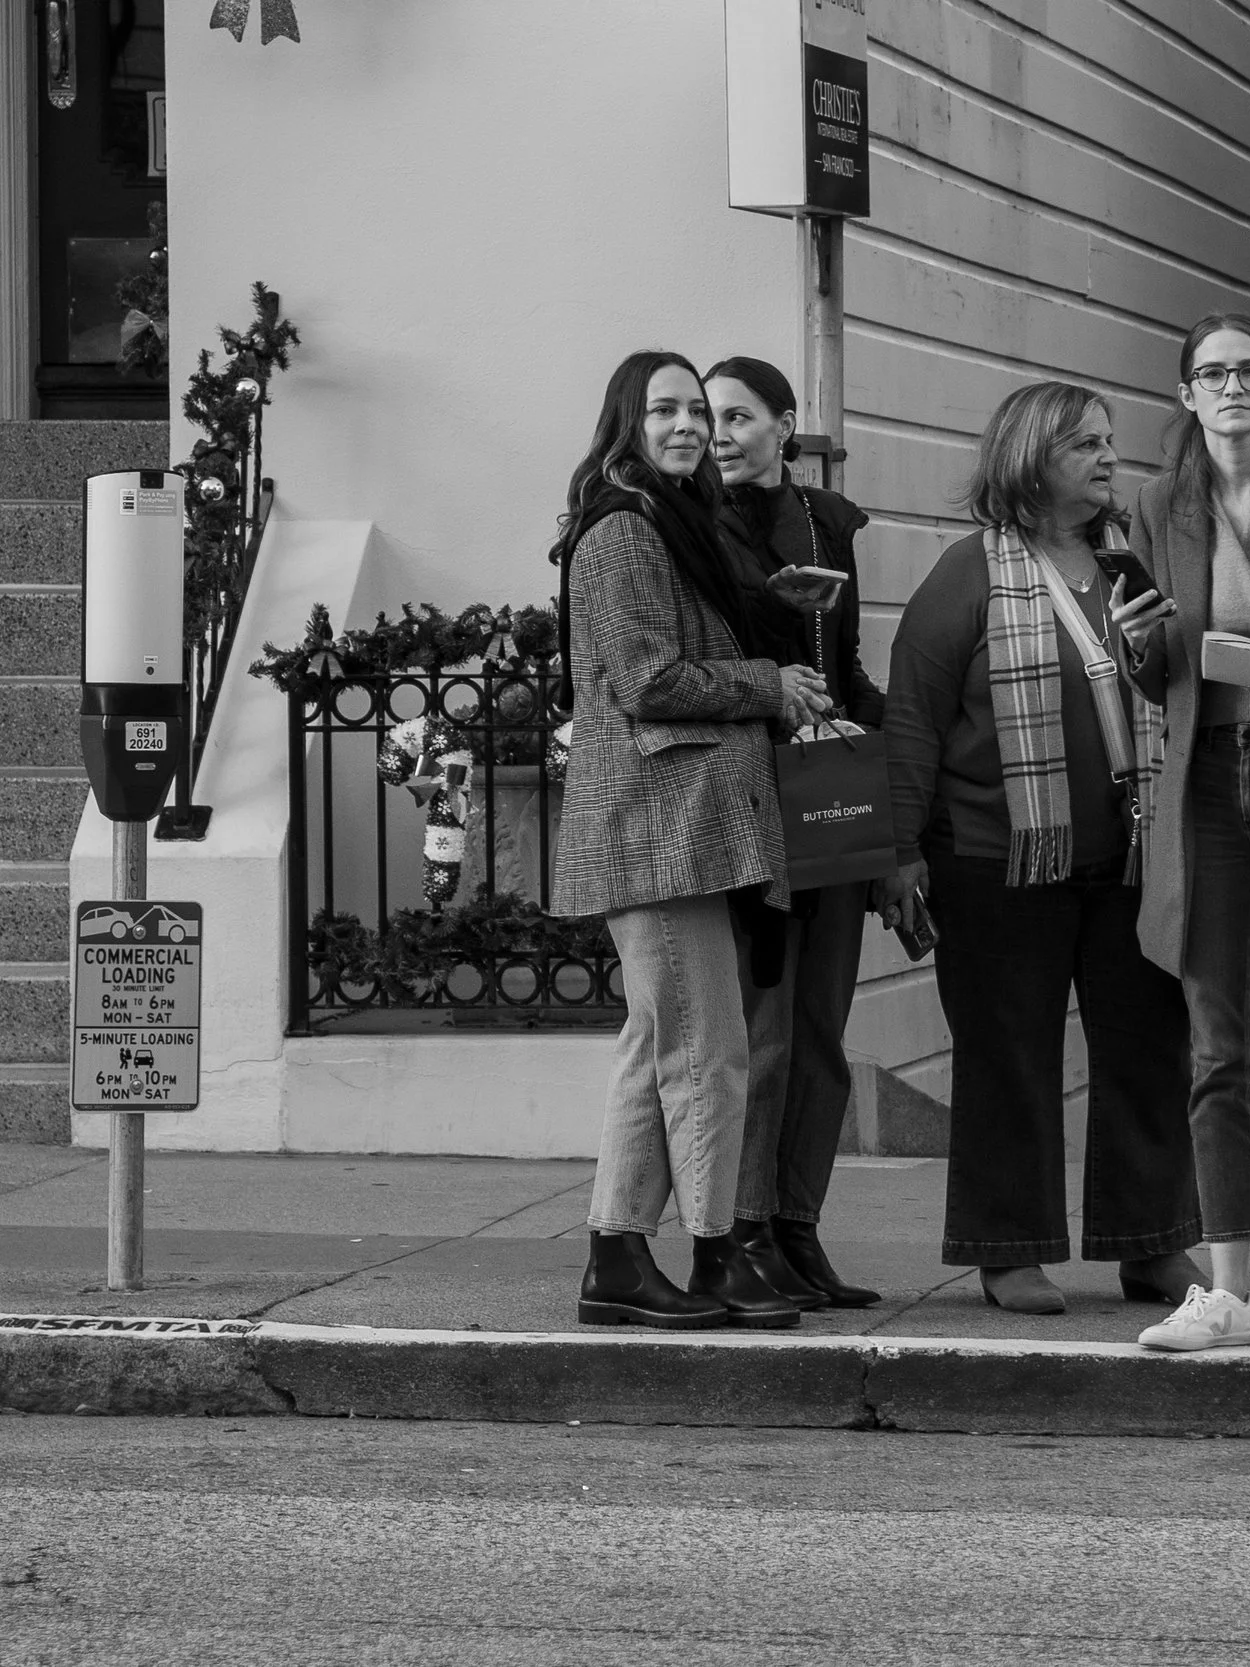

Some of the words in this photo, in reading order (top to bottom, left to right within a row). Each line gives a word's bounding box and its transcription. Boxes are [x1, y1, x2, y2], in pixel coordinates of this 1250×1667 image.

[812, 79, 861, 126] CHRISTIE'S
[136, 728, 156, 738] 691
[129, 739, 163, 749] 20240
[802, 808, 842, 822] BUTTON
[843, 804, 873, 817] DOWN
[84, 948, 194, 965] COMMERCIAL
[102, 967, 175, 984] LOADING
[134, 998, 143, 1006] TO
[103, 1012, 132, 1024] MON
[146, 1012, 172, 1024] SAT
[80, 1033, 138, 1045] 5-MINUTE
[141, 1033, 194, 1045] LOADING
[101, 1089, 130, 1100] MON
[145, 1088, 171, 1100] SAT
[37, 1318, 211, 1333] SFMTA
